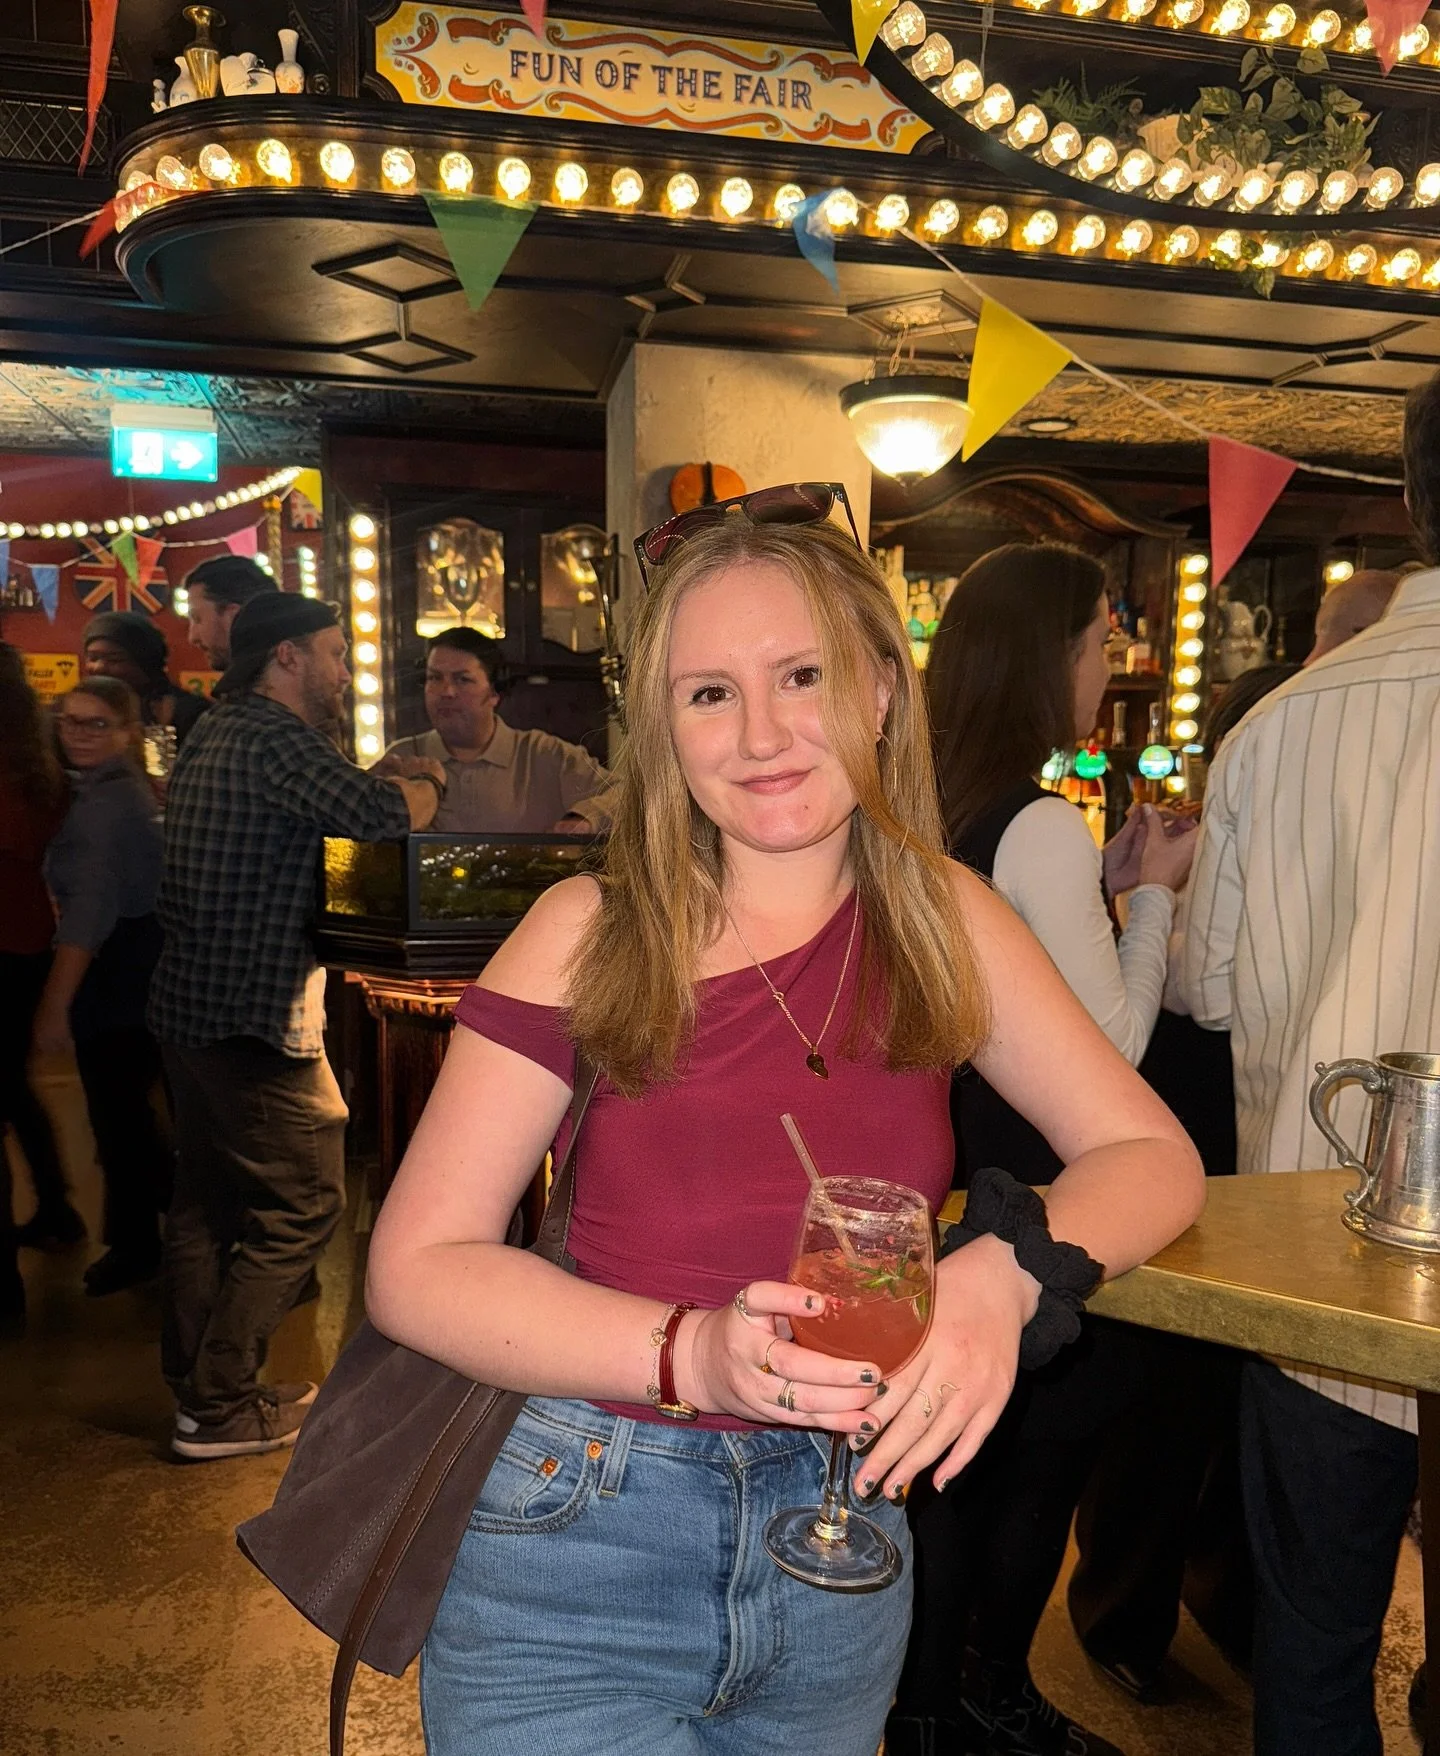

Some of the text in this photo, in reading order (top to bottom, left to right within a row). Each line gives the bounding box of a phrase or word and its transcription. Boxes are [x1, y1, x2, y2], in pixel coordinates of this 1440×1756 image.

[509, 49, 814, 110] FUN OF THE FAIR
